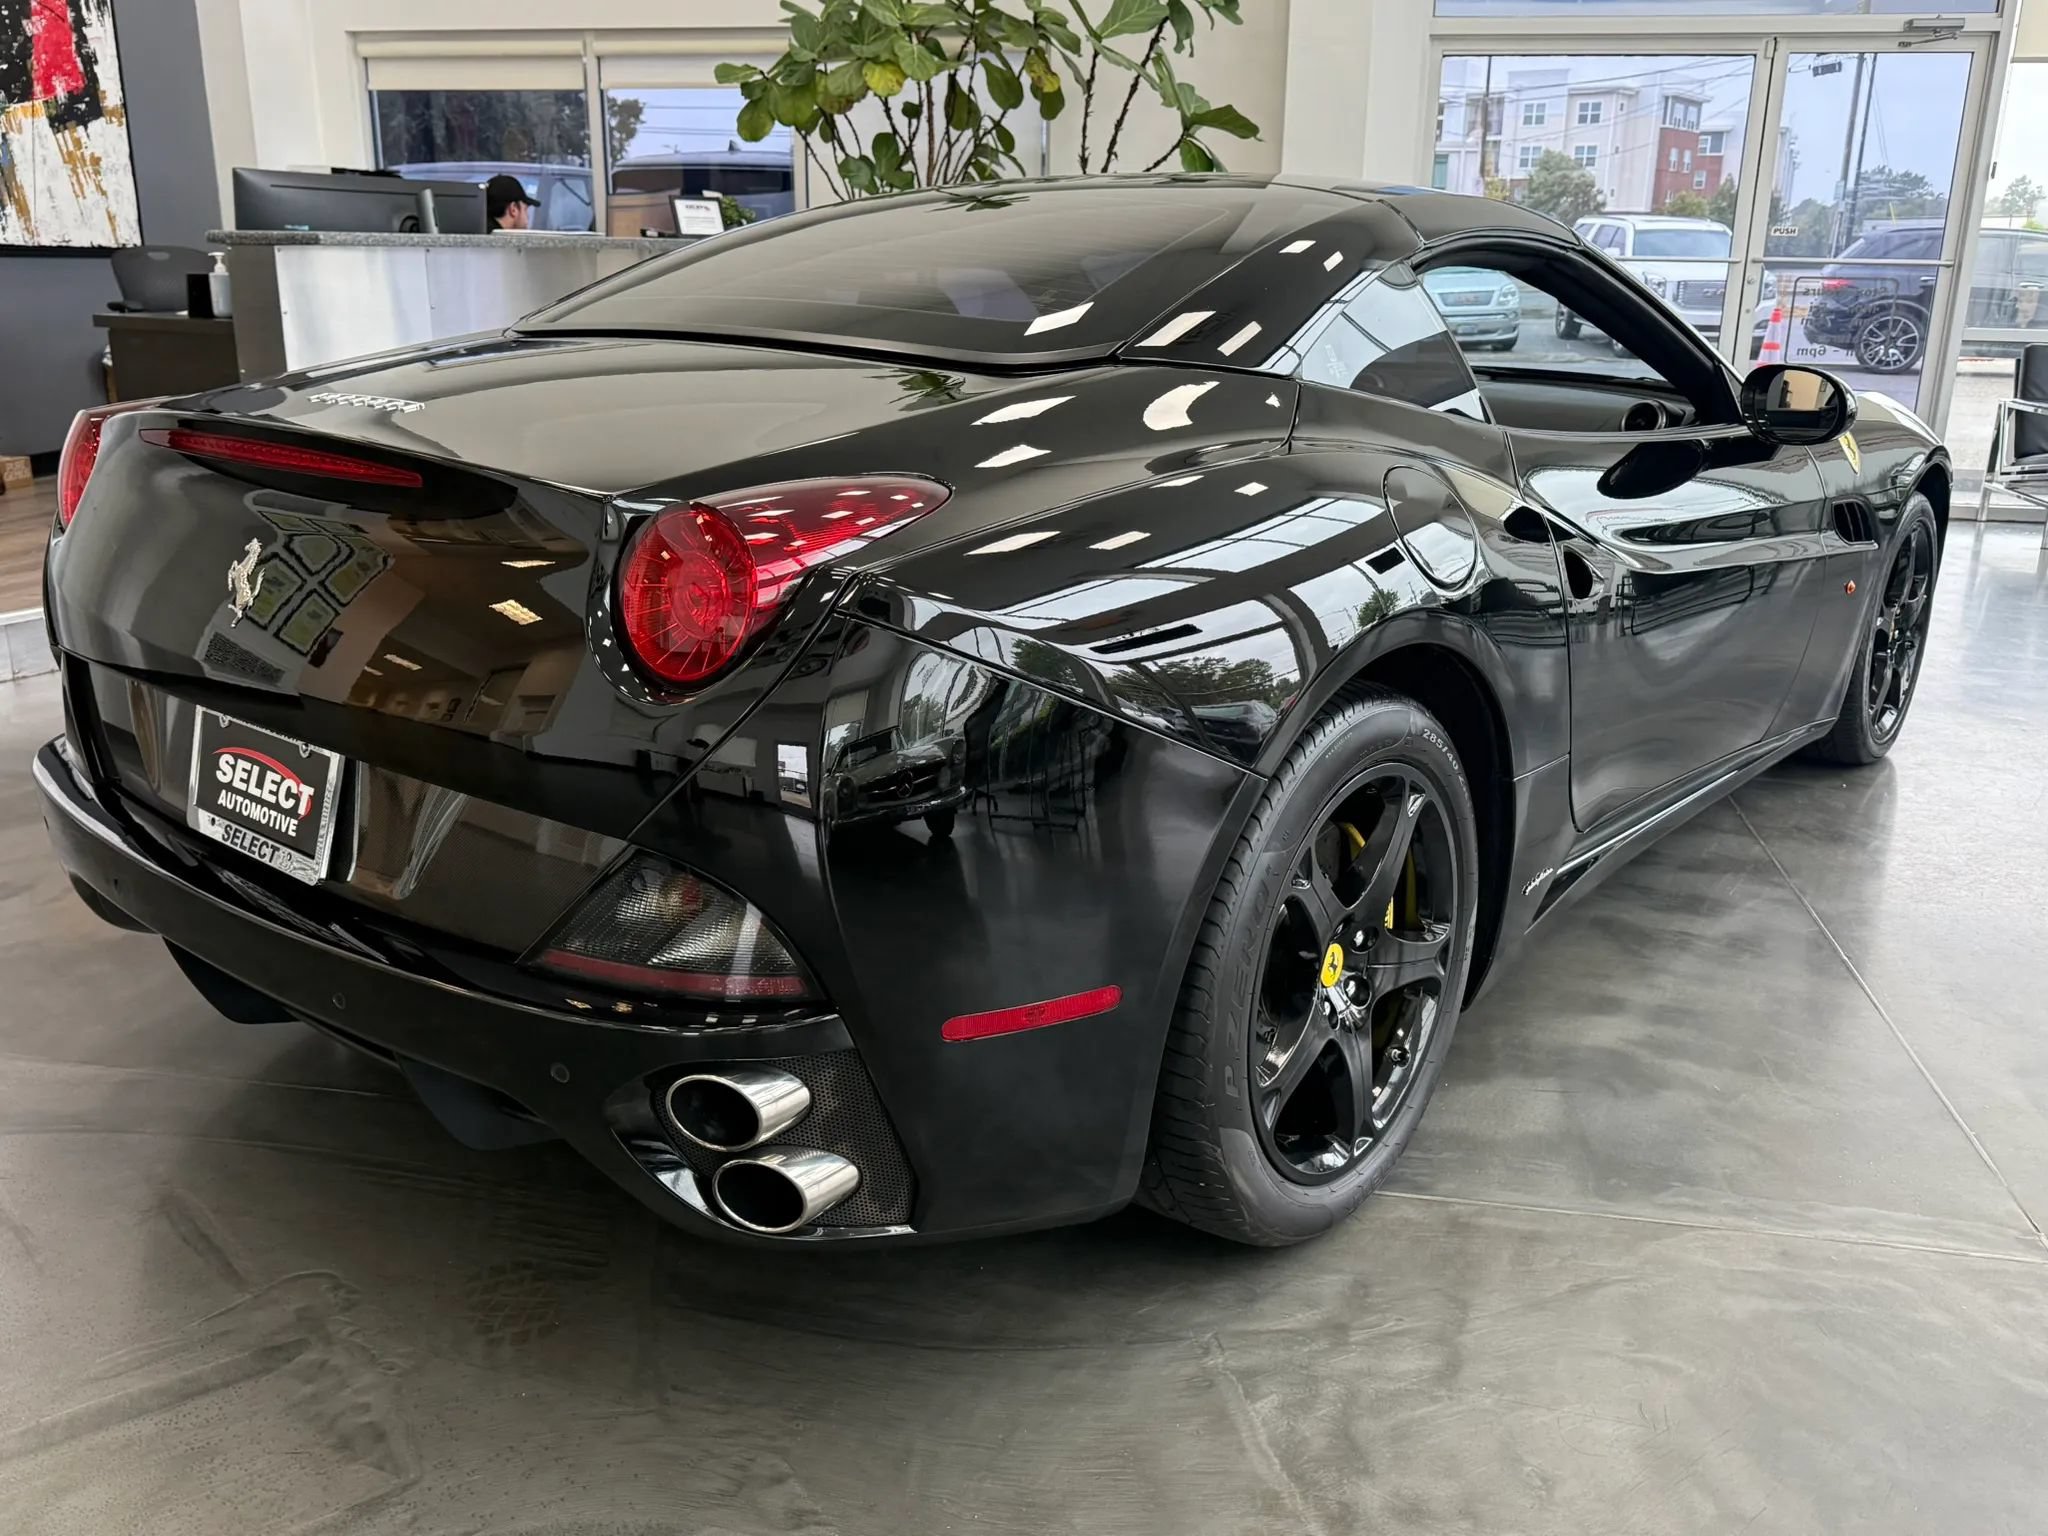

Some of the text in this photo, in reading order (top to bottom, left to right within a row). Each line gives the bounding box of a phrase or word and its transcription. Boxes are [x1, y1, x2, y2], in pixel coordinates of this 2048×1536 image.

[1772, 227, 1797, 235] PUSH
[215, 753, 315, 816] SELECT
[217, 788, 299, 837] AUTOMOTIVE
[221, 824, 281, 863] SELECT
